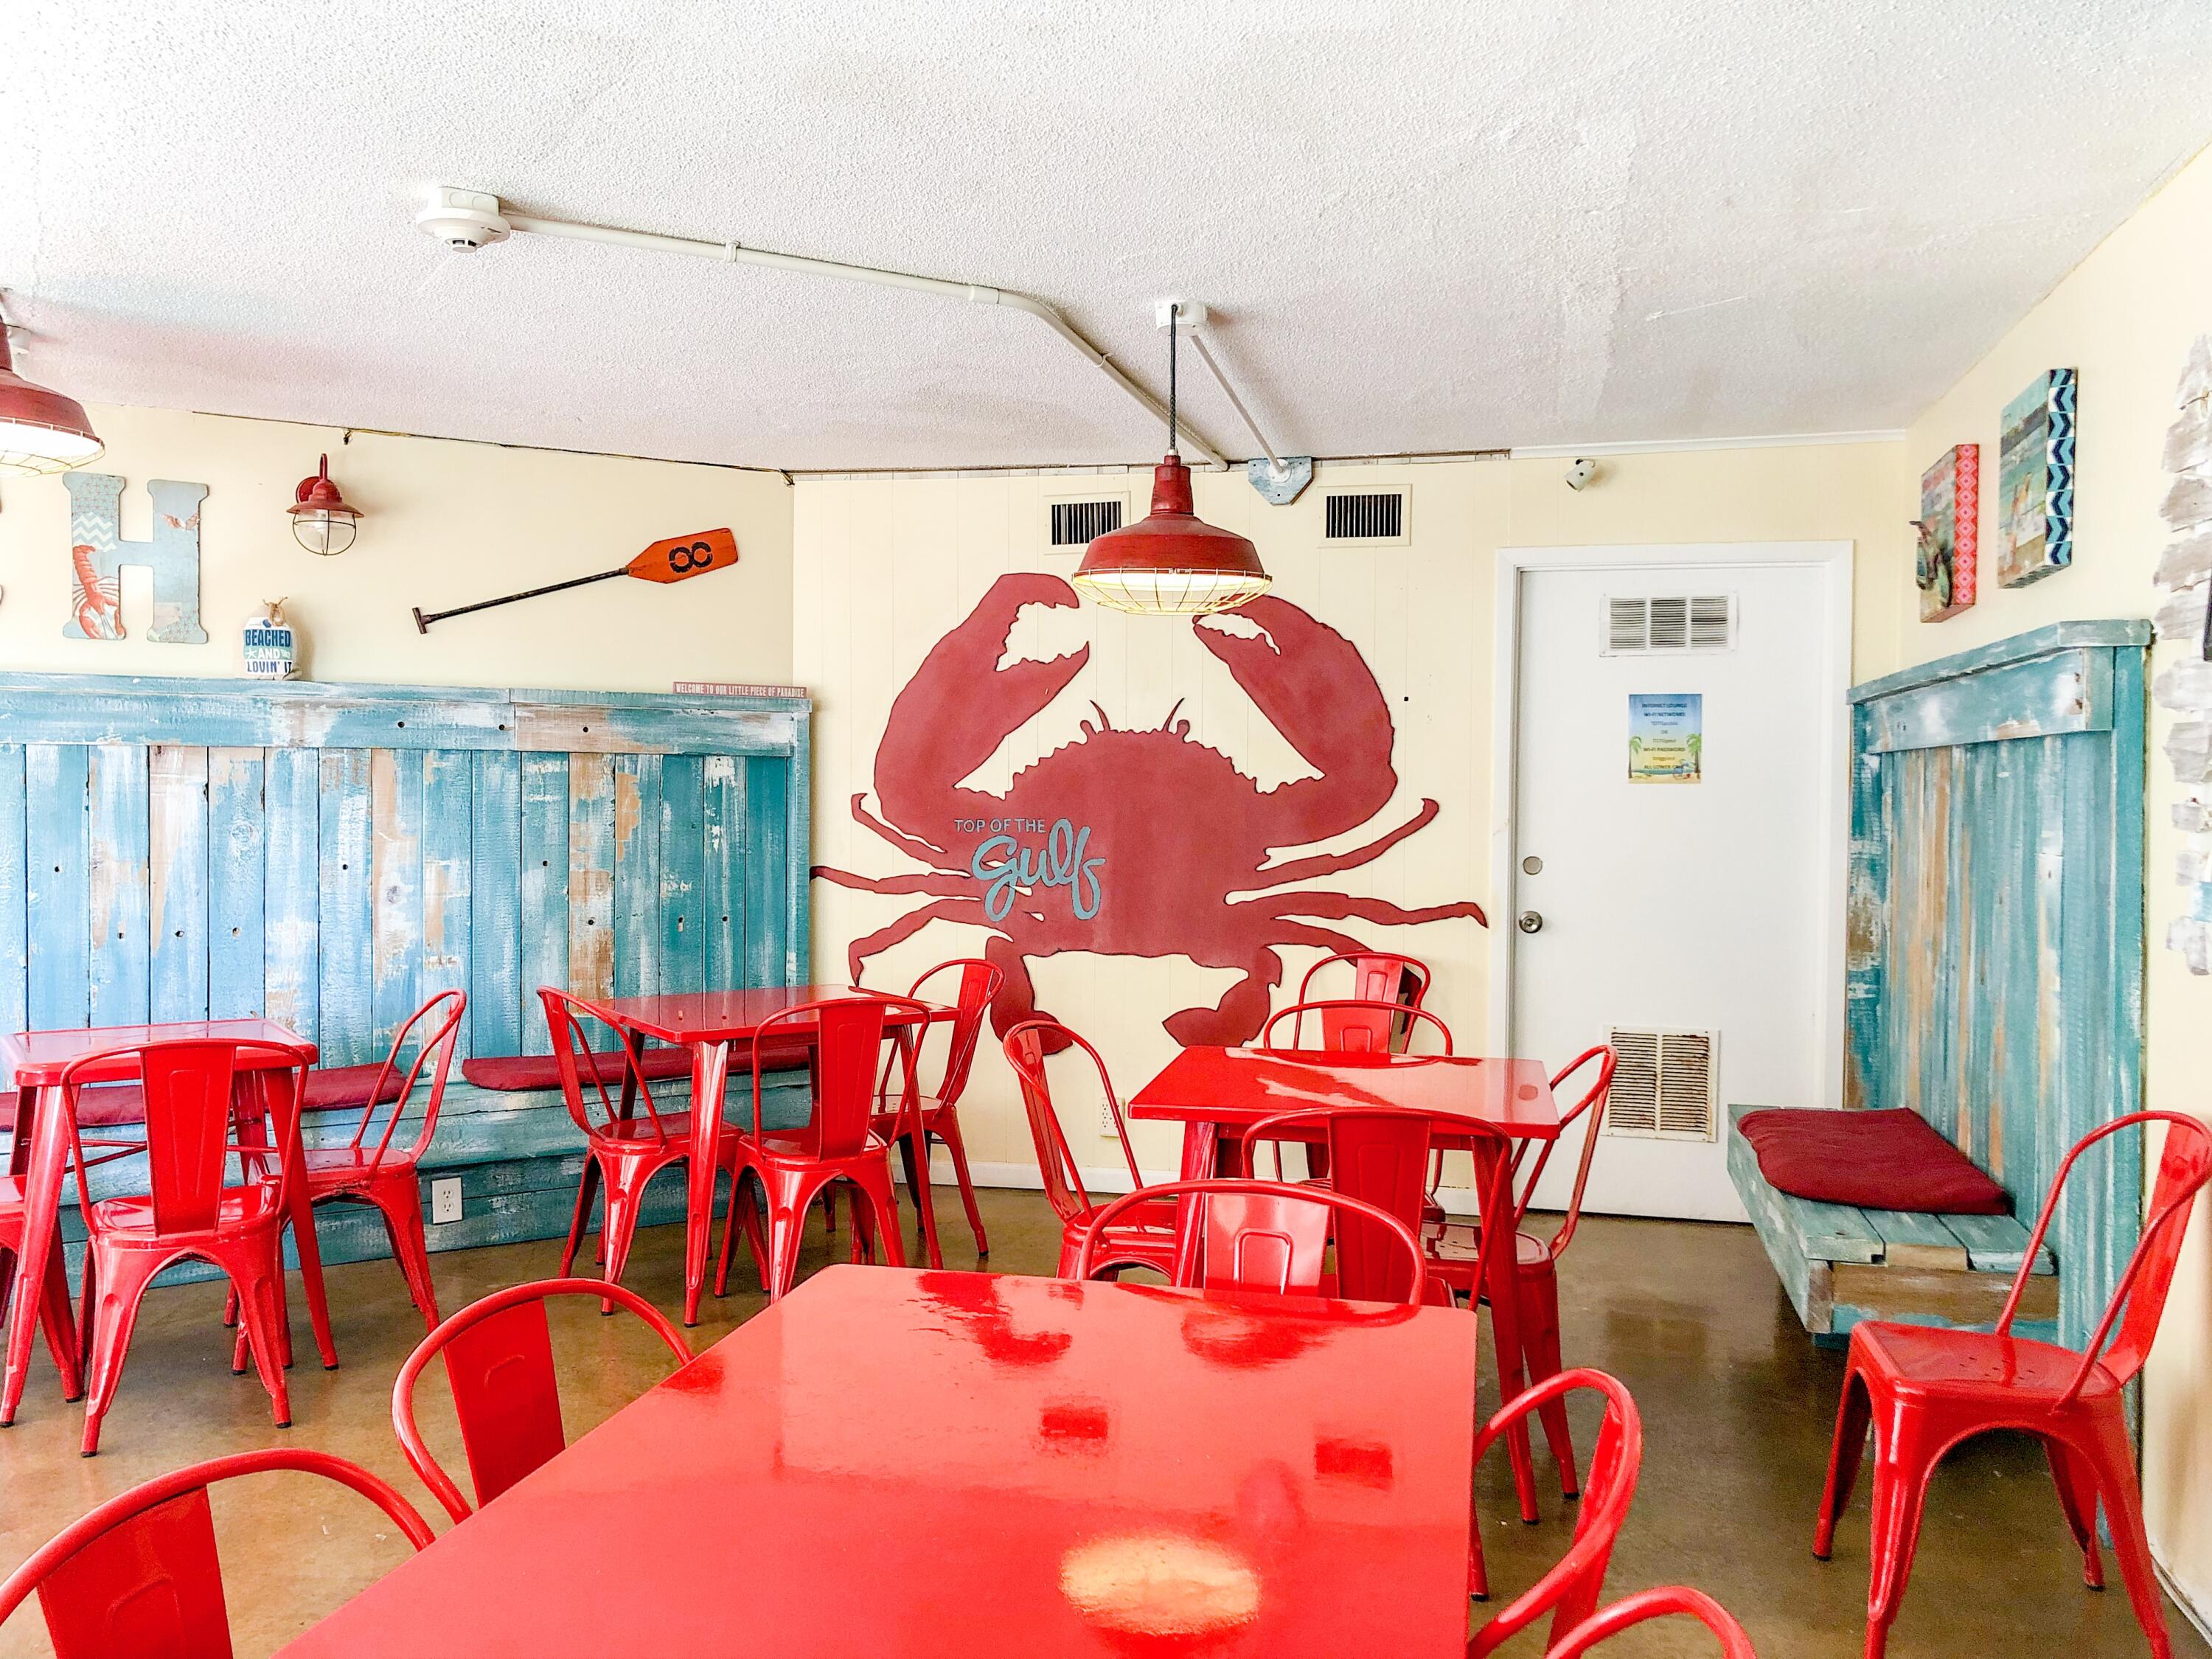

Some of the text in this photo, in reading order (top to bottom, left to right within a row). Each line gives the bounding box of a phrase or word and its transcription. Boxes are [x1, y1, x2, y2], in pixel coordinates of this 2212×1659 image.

[245, 629, 291, 647] BEACHED
[257, 647, 280, 659] AND
[247, 661, 292, 674] LOVIN' IT
[675, 684, 804, 698] WELCOME TO OUR LITTLE PIECE OF PARADISE
[954, 818, 1046, 833] TOP OF THE
[972, 818, 1106, 922] Gulf
